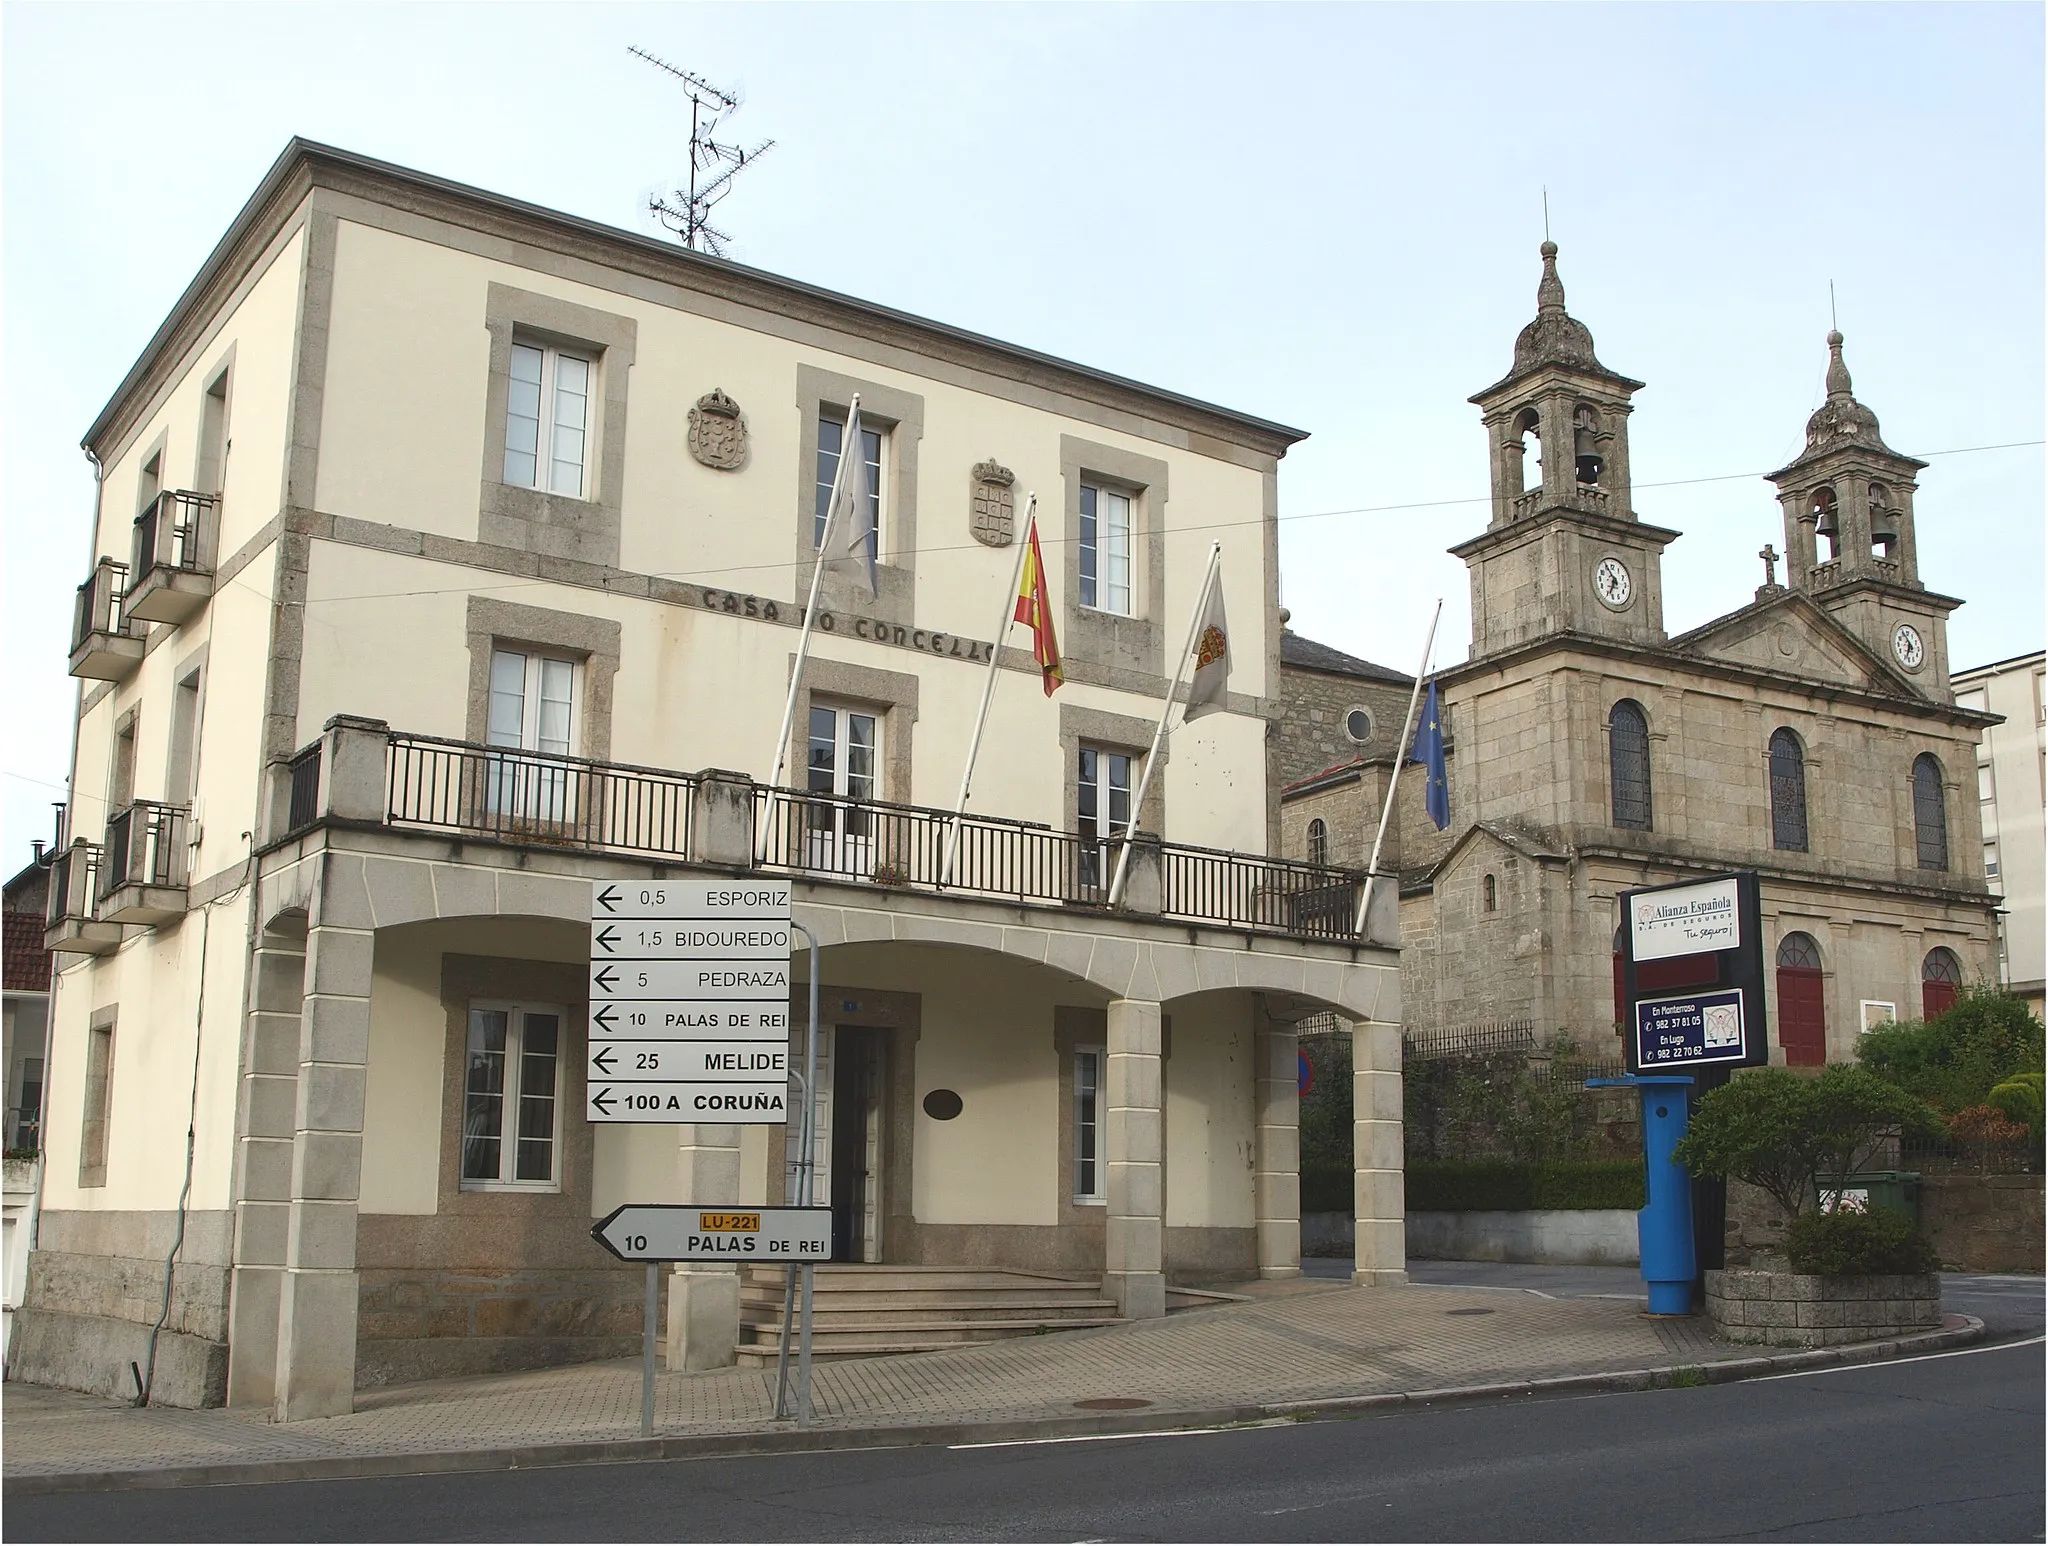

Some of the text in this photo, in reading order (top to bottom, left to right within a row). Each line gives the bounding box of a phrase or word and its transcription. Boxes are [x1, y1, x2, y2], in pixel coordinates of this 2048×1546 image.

[703, 590, 778, 620] CASA
[640, 891, 788, 906] 0,5 ESPORIZ
[1656, 897, 1730, 918] Alianza Española
[1683, 913, 1731, 924] SEGUROS
[638, 932, 787, 948] 1,5 BIDOUREDO
[1684, 929, 1698, 938] Tu
[638, 972, 786, 986] 5 PEDRAZA
[1652, 1005, 1695, 1016] En Monterroso
[630, 1013, 786, 1026] 10 PALAS DE REI
[1656, 1016, 1700, 1029] 982 37 81 05
[1660, 1035, 1684, 1045] En Lugo
[1658, 1046, 1702, 1058] 982 22 70 62
[636, 1054, 784, 1070] 25 MELIDE
[625, 1092, 783, 1110] 100 A CORUÑA
[703, 1217, 758, 1228] LU-221
[626, 1236, 824, 1252] 10 PALAS DE REI
